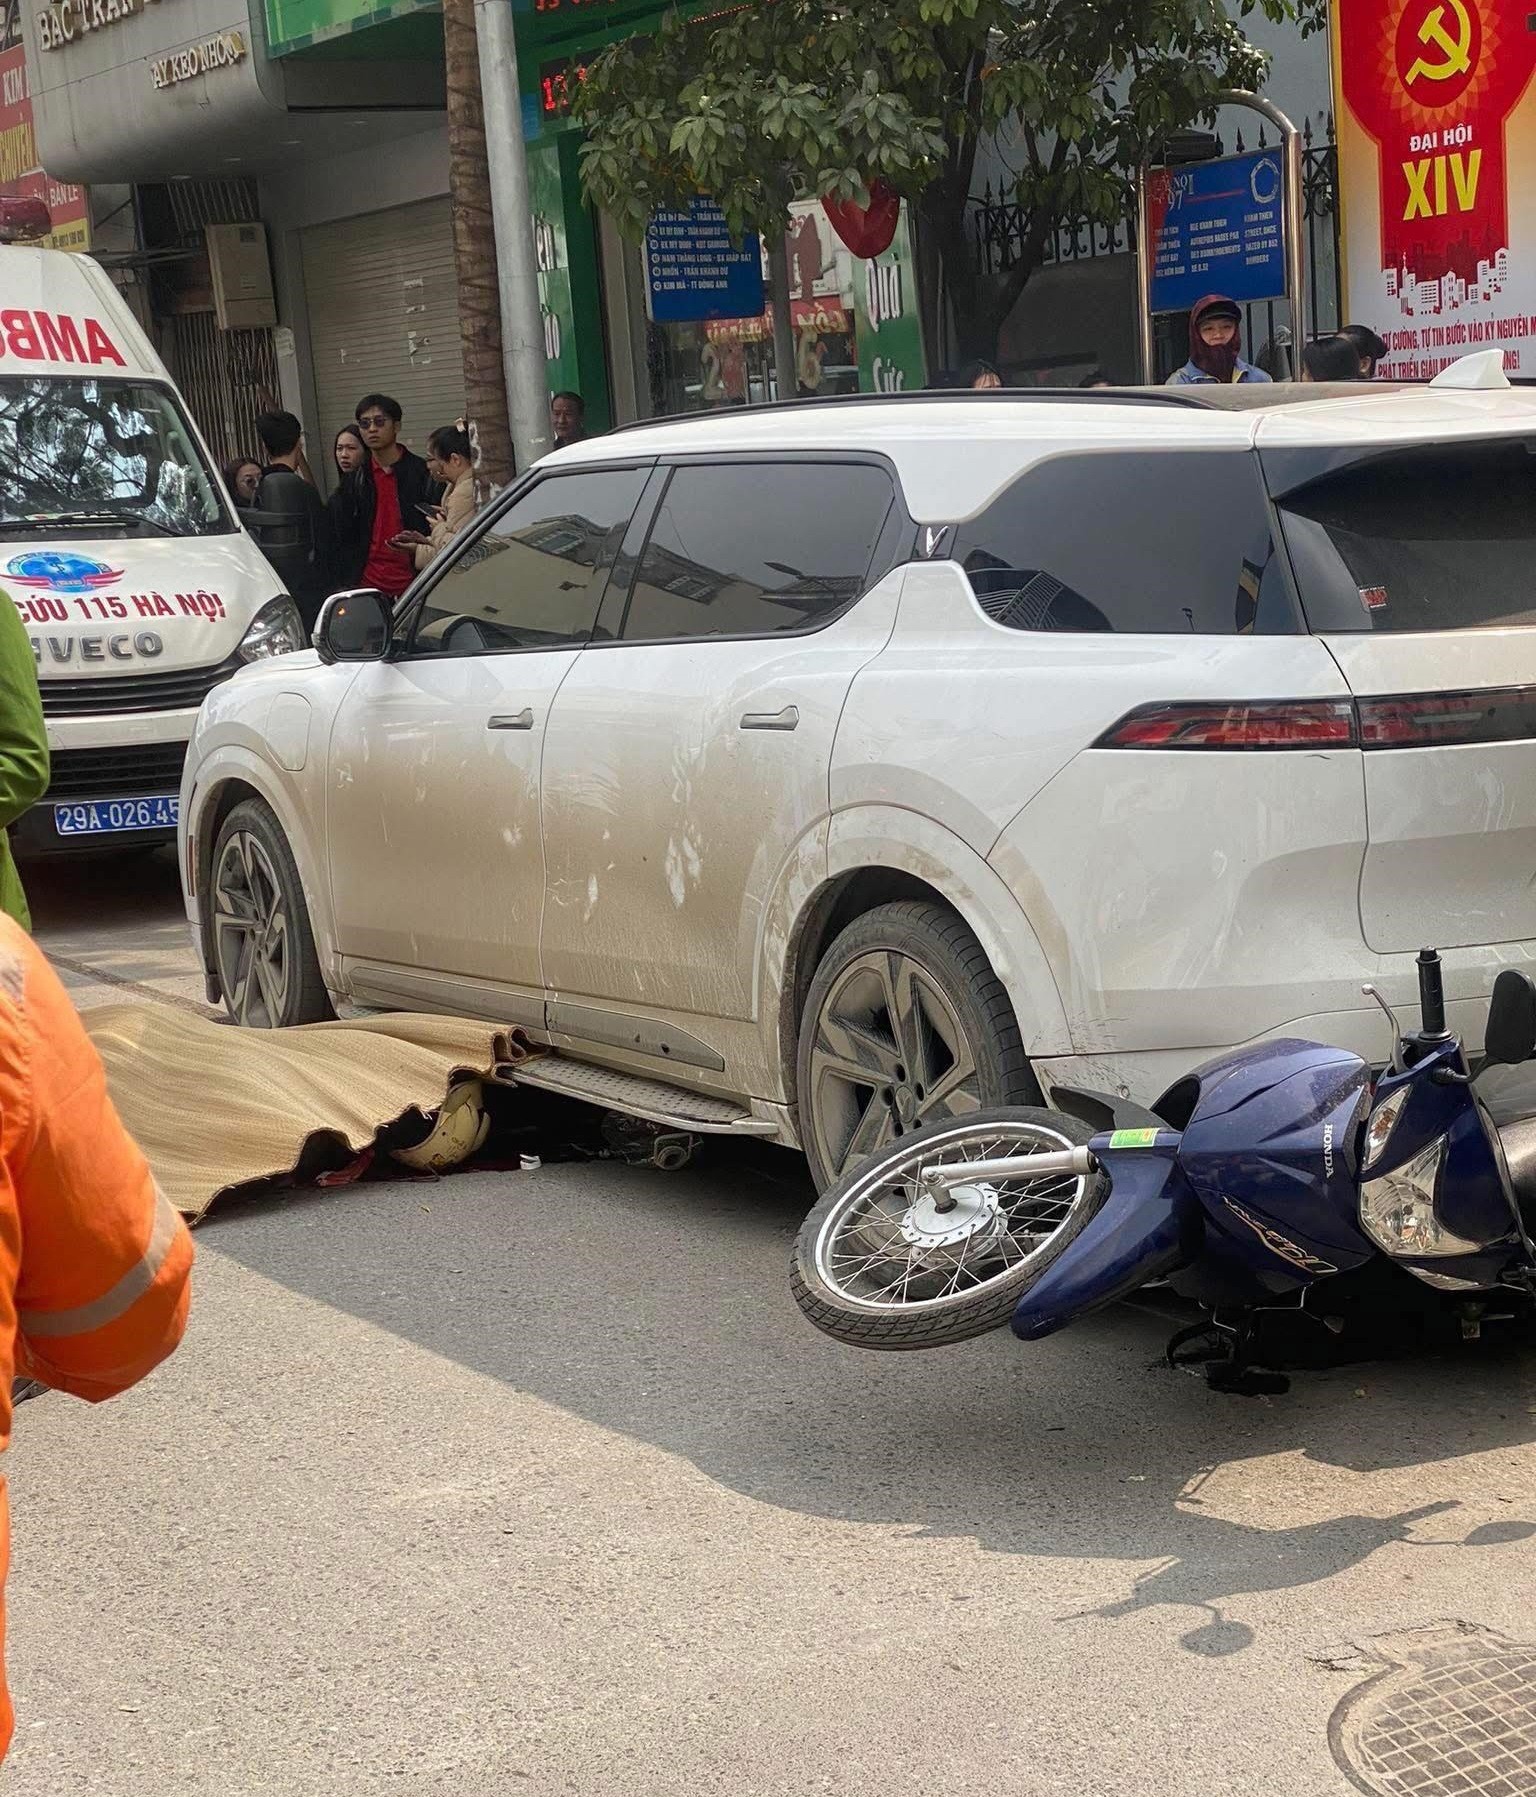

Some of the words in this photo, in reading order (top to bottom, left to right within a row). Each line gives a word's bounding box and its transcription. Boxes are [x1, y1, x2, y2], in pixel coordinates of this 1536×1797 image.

[1410, 132, 1438, 153] ĐẠI
[1443, 123, 1473, 147] HỘI
[1401, 148, 1482, 221] XIV
[1393, 327, 1420, 351] CƯỜNG,
[1432, 326, 1445, 347] TIN
[1446, 319, 1467, 345] BƯỚC
[1468, 319, 1483, 342] VÀO
[1497, 313, 1529, 338] NGUYÊN
[74, 595, 129, 620] 115
[130, 590, 176, 617] HÀ
[175, 589, 227, 623] NỘI
[1323, 1124, 1335, 1179] HONDA
